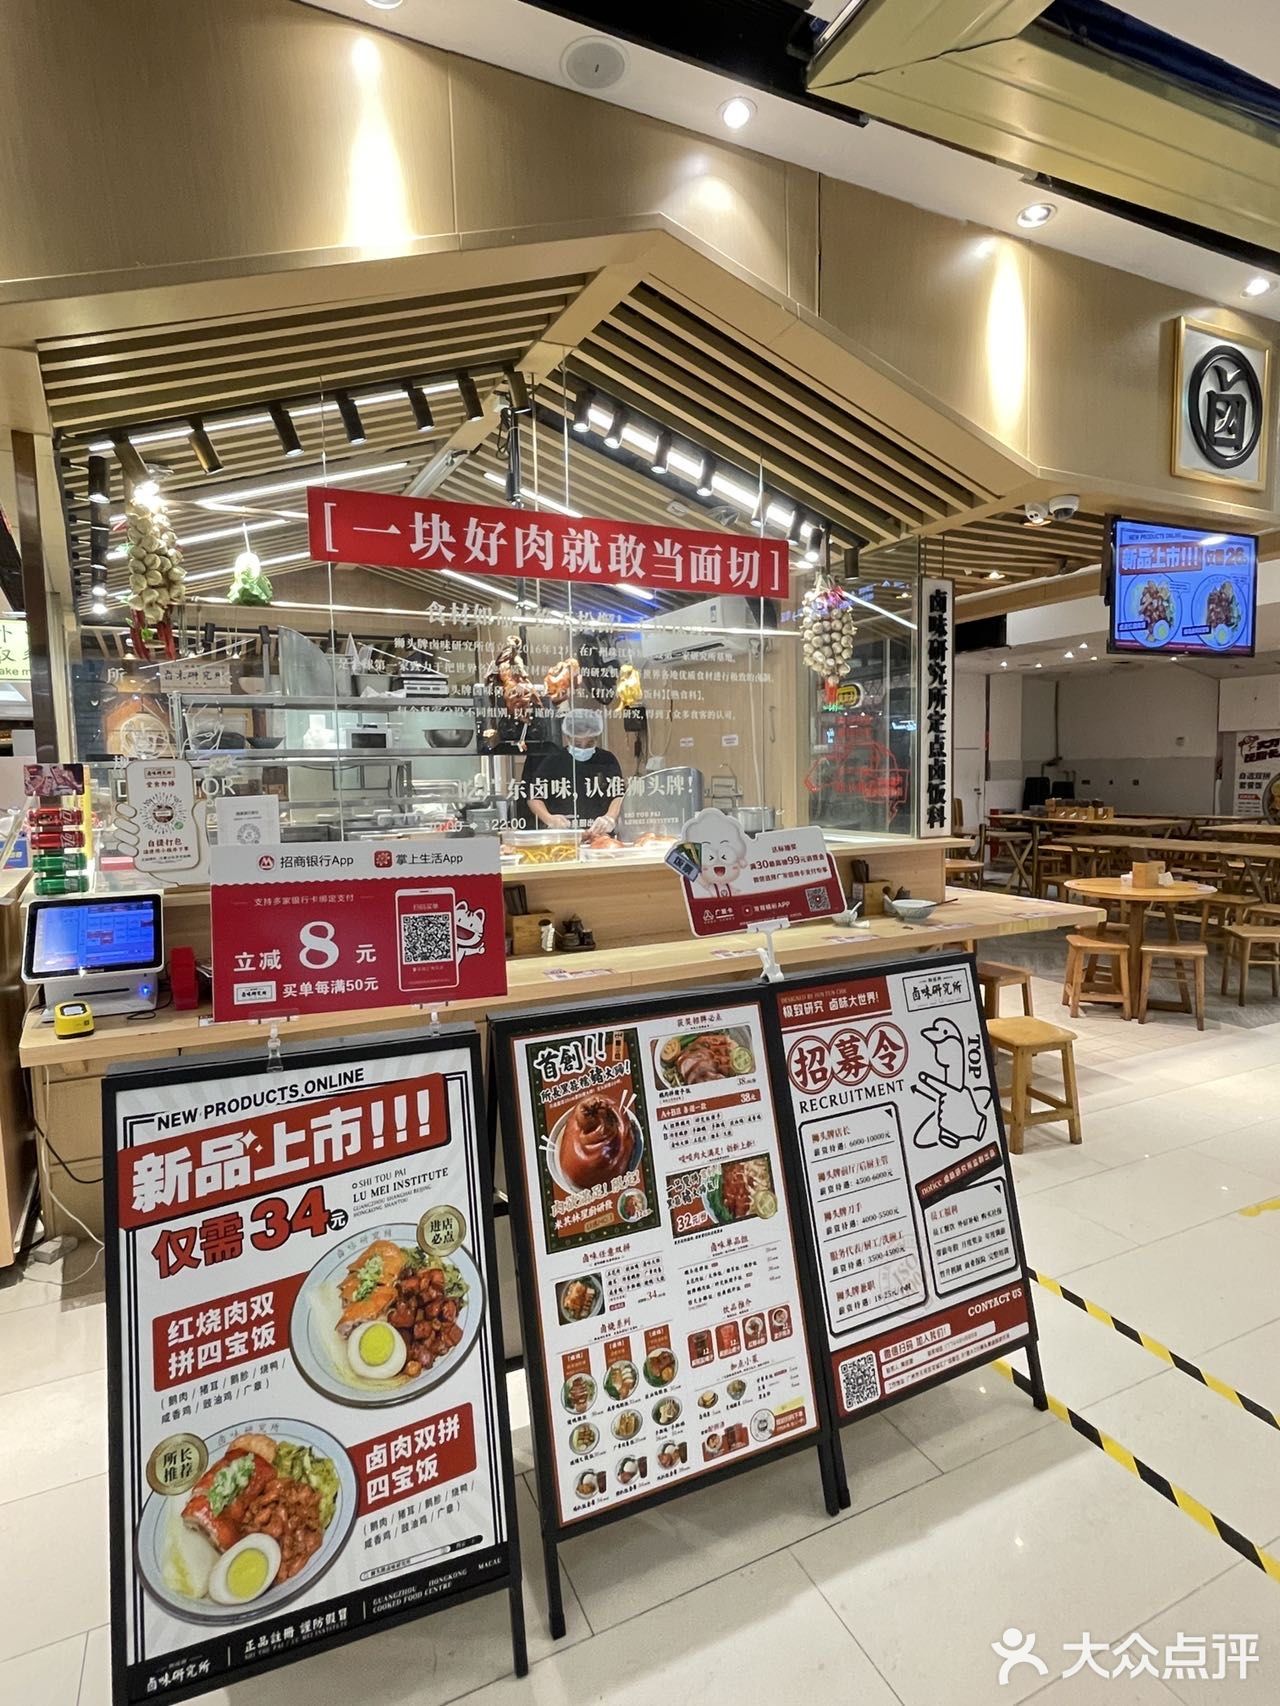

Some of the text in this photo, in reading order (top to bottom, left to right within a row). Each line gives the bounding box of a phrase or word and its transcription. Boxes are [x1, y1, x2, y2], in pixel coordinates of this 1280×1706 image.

[491, 818, 527, 831] 22:00
[280, 853, 464, 869] 招商银行App 掌上生活App
[233, 920, 378, 973] 立减 8 元
[281, 976, 380, 999] 买单每满50元
[911, 980, 963, 1001] 卤味研究所
[783, 1001, 825, 1018] 极致研究
[794, 1029, 904, 1088] 招募令
[967, 1033, 982, 1080] TOP
[156, 1067, 365, 1132] NEW PRODUCTS ONLINE
[799, 1079, 905, 1114] RECRUITMENT
[131, 1088, 432, 1214] 新品上市!!!
[353, 1167, 449, 1203] LU MEI INSTITUTE
[358, 1177, 372, 1189] SHI
[374, 1172, 392, 1184] TOU
[430, 1217, 453, 1233] 进店
[431, 1231, 455, 1245] 必点
[967, 1287, 1023, 1318] CONTACT US
[167, 1291, 275, 1348] 红烧肉双
[168, 1320, 277, 1380] 拼四宝饭
[162, 1447, 193, 1468] 所长
[365, 1413, 461, 1475] 卤肉双拼
[163, 1464, 194, 1483] 推荐
[366, 1452, 440, 1505] 四宝饭
[372, 1595, 401, 1615] COOKED
[146, 1659, 212, 1693] 卤味研究所
